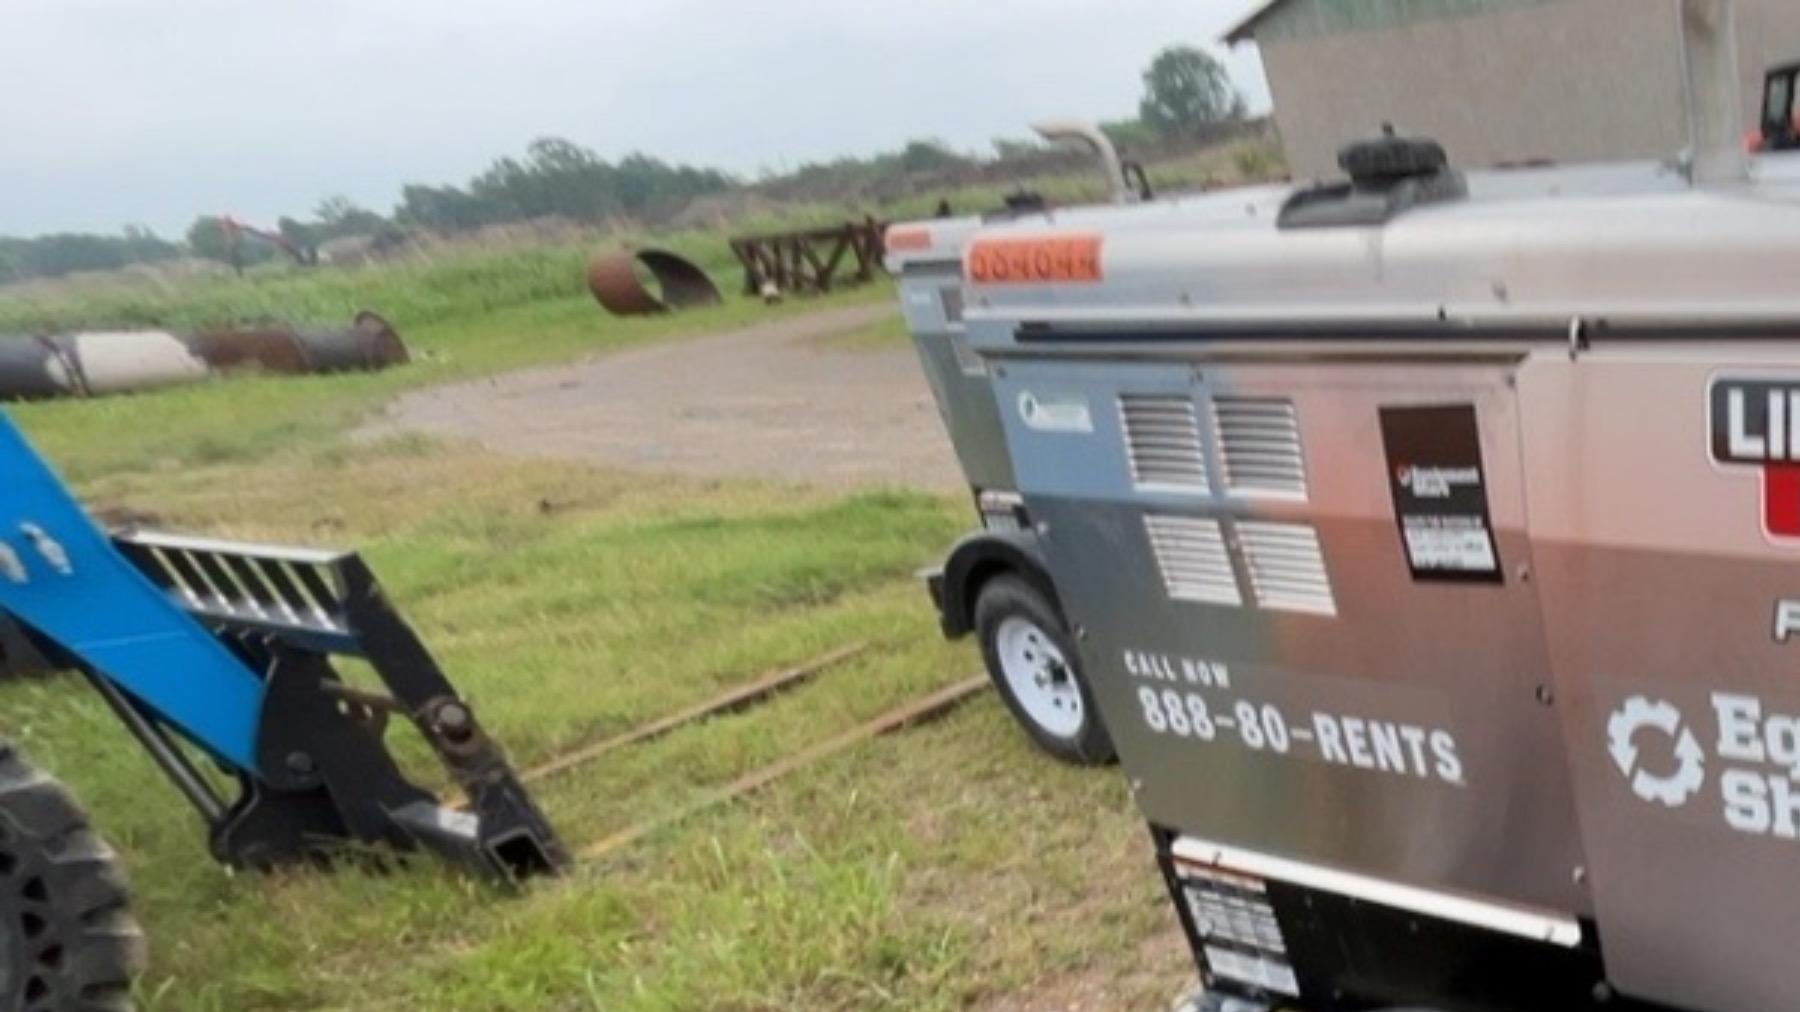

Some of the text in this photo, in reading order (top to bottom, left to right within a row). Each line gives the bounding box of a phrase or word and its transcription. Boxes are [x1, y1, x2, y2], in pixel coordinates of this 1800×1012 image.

[1124, 650, 1230, 688] CALL NOW
[1137, 685, 1464, 784] 888-80-RENTS
